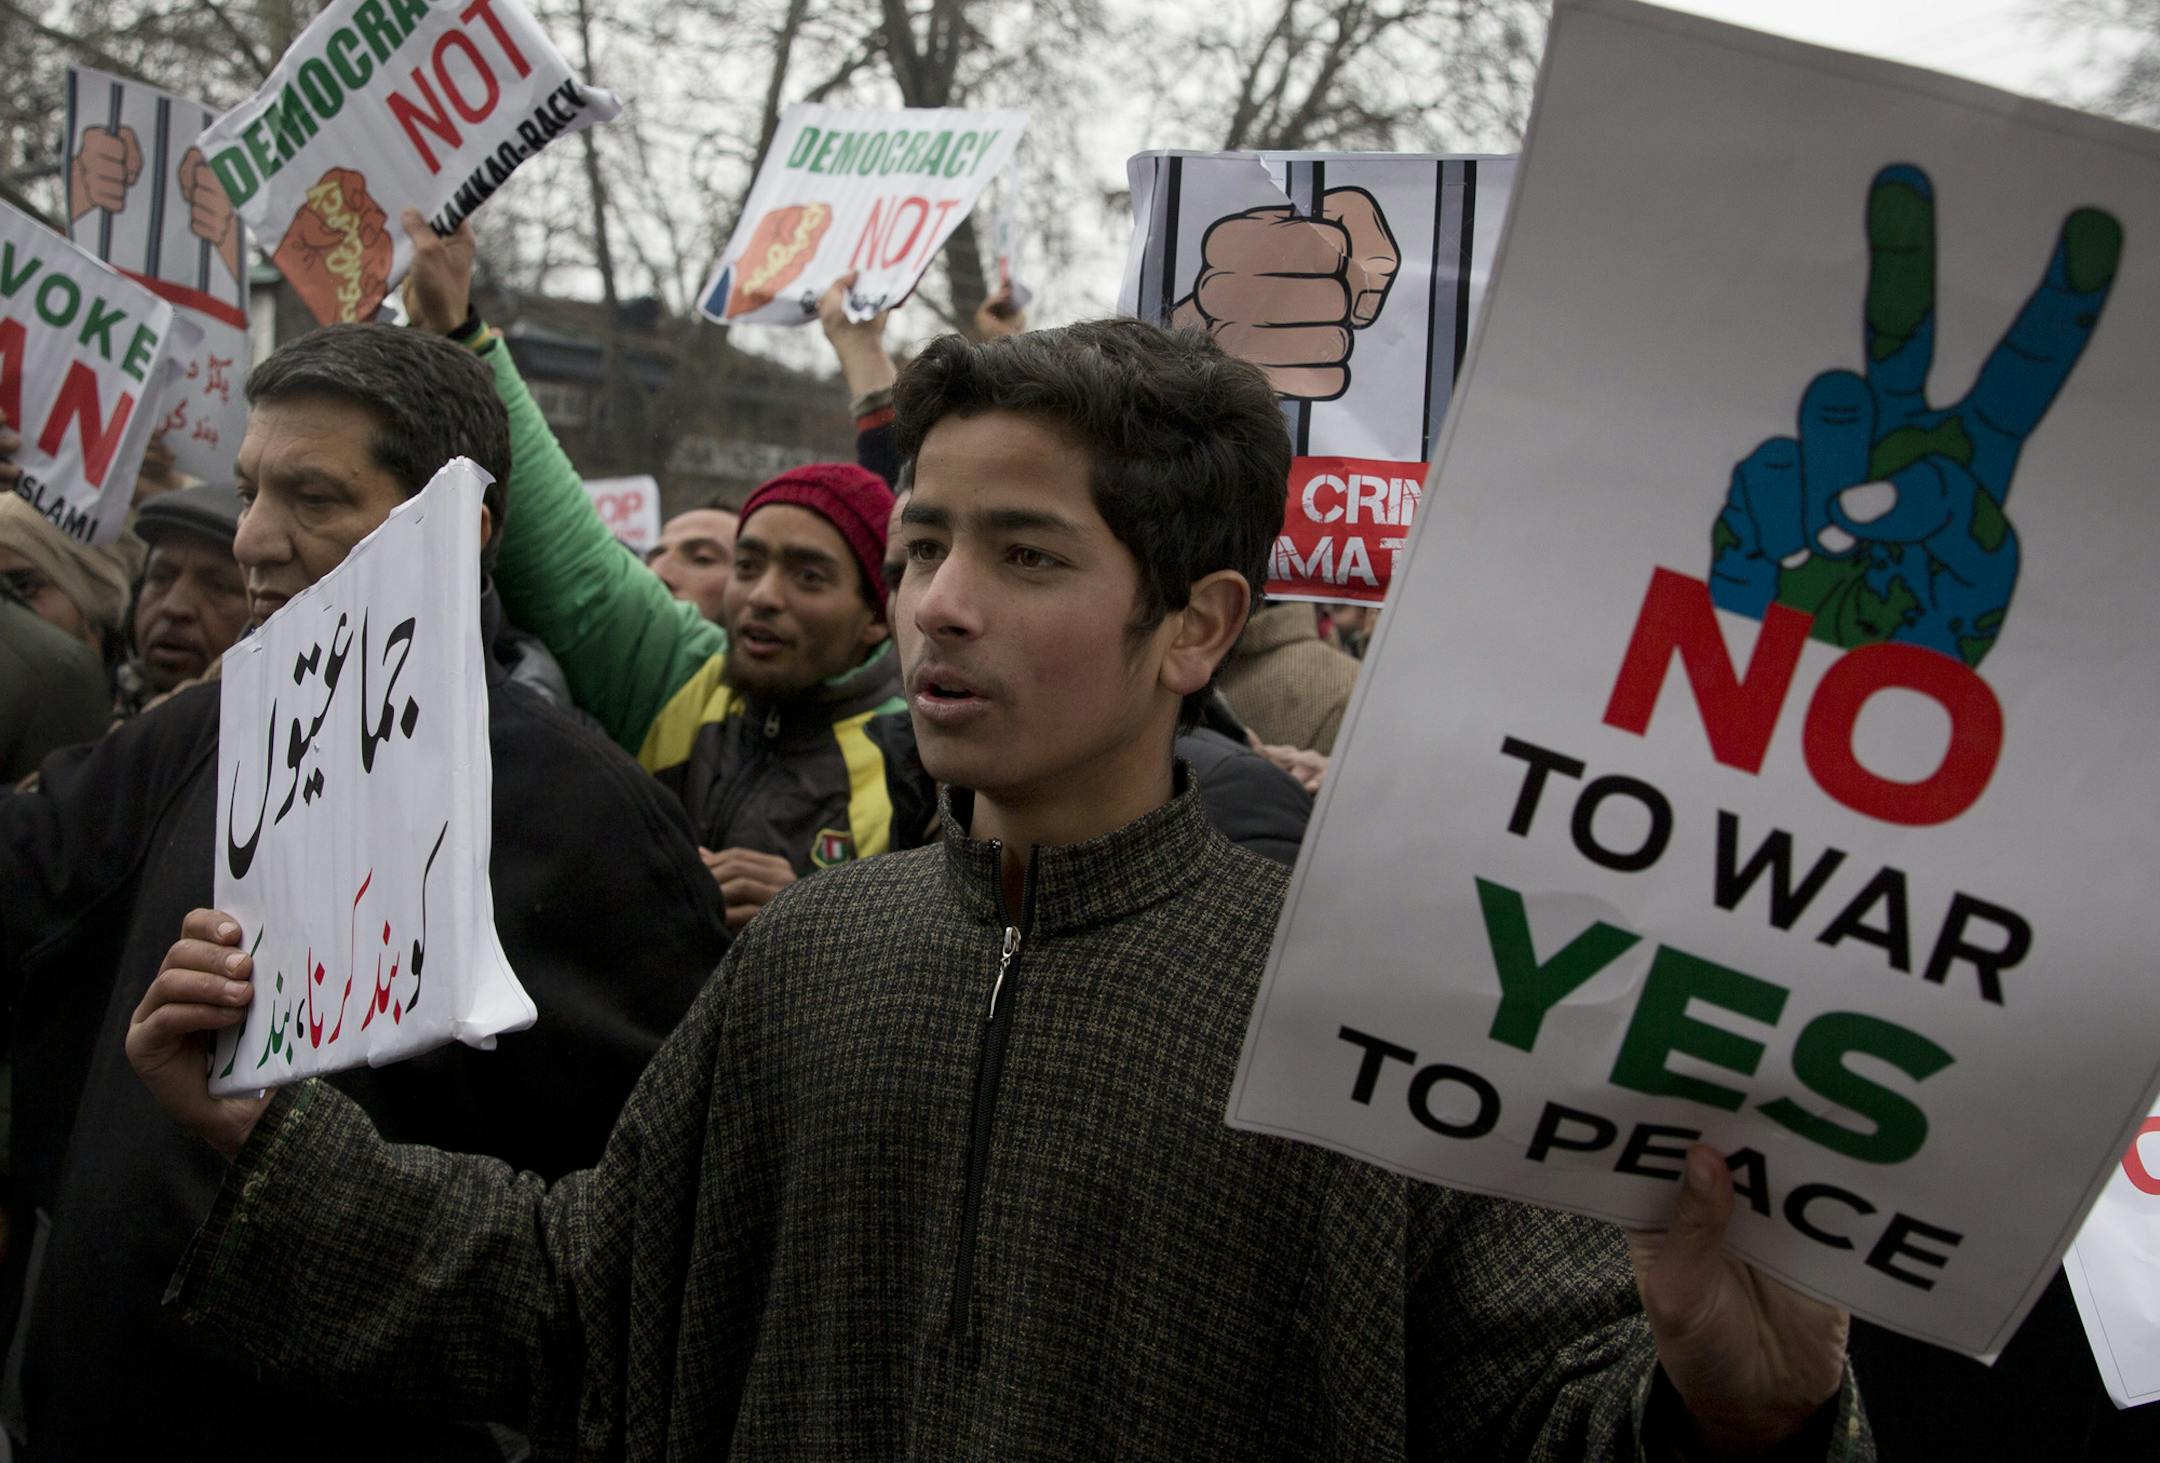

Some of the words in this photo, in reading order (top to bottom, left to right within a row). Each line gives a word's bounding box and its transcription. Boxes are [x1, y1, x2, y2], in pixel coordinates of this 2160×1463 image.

[209, 0, 440, 208] DEMOCRA
[386, 0, 532, 176] NOT
[785, 126, 1001, 178] DEMOCRACY
[1, 240, 158, 383] VOKE
[849, 196, 960, 272] NOT
[1602, 566, 2005, 828] NO
[405, 820, 448, 1014] کو
[1501, 735, 1674, 873] TO
[1715, 809, 2033, 1006] WAR
[256, 971, 293, 1069] بند
[361, 919, 402, 1032] بند
[1475, 876, 1957, 1166] YES
[1337, 1025, 1503, 1140] TO
[1524, 1100, 1965, 1292] PEACE
